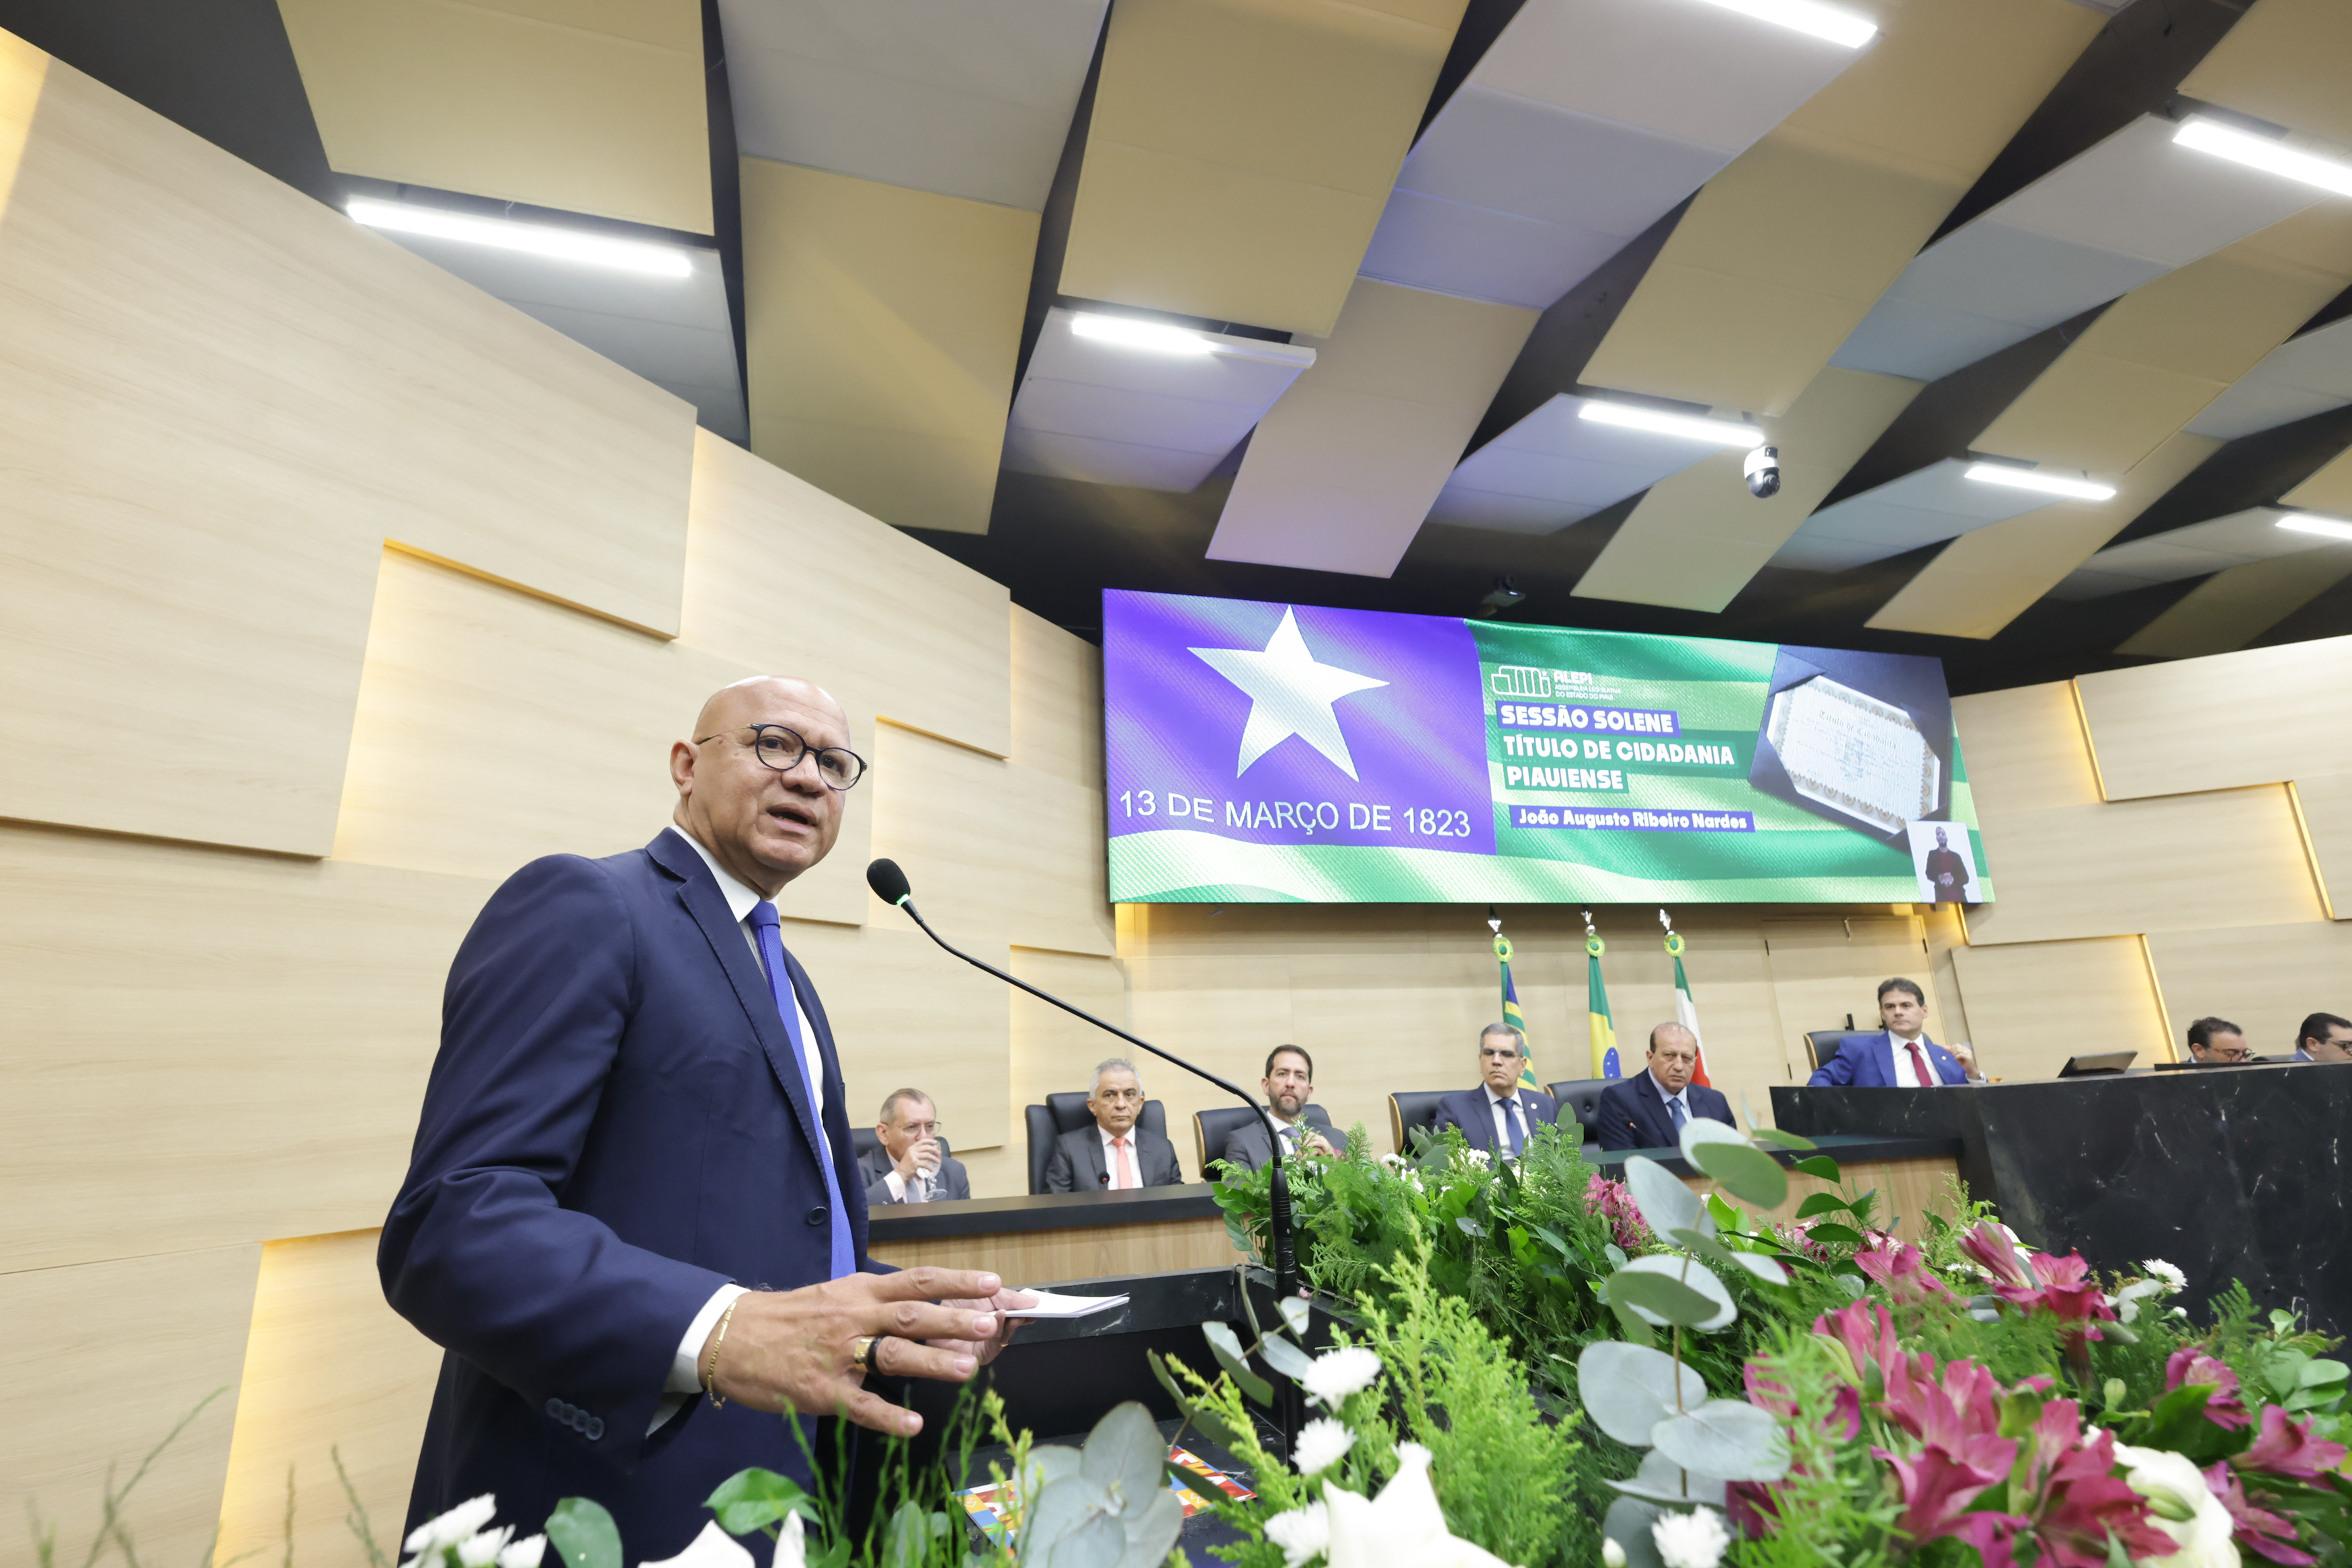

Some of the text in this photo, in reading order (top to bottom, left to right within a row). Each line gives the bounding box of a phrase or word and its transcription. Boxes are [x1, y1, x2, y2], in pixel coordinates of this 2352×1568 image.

[1554, 670, 1593, 685] ALEPI
[1501, 705, 1673, 733] SESSÃO SOLENE
[1503, 734, 1735, 765] TÍTULO DE CIDADANIA
[1507, 766, 1624, 789] PIAUIENSE
[1120, 790, 1471, 837] 13 DE MARÇO DE 1823
[1519, 808, 1747, 829] João Augusto Ribeiro Nardes
